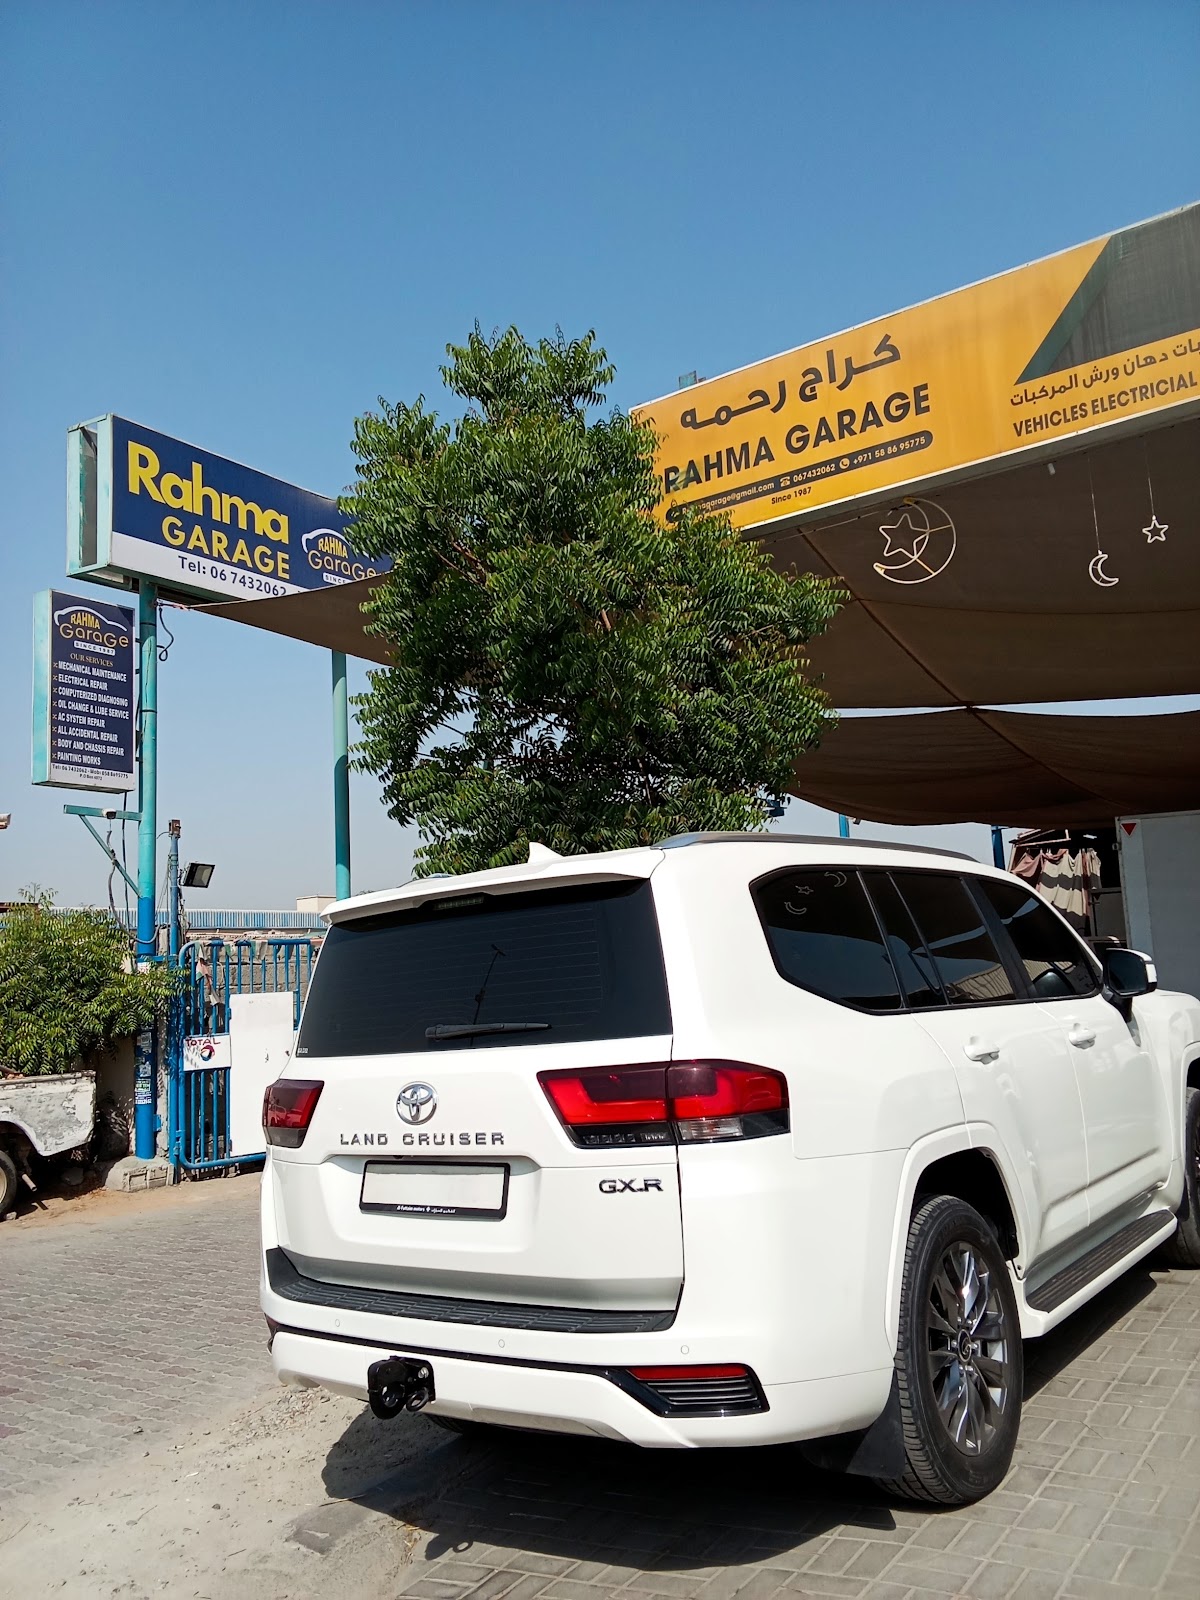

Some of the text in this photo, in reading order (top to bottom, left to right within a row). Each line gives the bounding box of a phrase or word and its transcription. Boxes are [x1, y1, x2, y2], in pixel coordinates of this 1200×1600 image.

[799, 334, 900, 402] كراج
[1011, 374, 1078, 406] المركبات
[1013, 371, 1198, 437] VEHICLES ELECTRICIAL
[664, 383, 930, 494] RAHMA GARAGE
[793, 463, 836, 483] 067432062
[853, 452, 872, 465] +971
[875, 448, 885, 458] 58
[887, 446, 897, 455] 86
[900, 437, 926, 450] 95775
[128, 440, 289, 545] Rahma
[794, 487, 812, 498] 1987
[161, 516, 290, 580] GARAGE
[318, 536, 349, 559] RAHMA
[178, 555, 287, 597] Tel: 06 7432062
[71, 612, 100, 630] RAHMA
[75, 642, 115, 655] SINCE 1987
[70, 653, 113, 667] OUR SERVICES
[58, 661, 126, 682] MECHANICAL MAINTENANCE
[58, 674, 108, 691] ELECTRICAL REPAIR
[58, 686, 128, 707] COMPUTERIZED DIAGNOSING
[57, 712, 105, 728] AC SYSTEM REPAIR
[58, 699, 129, 720] OIL CHANGE & LUBE SERVICE
[57, 725, 118, 743] ALL ACCIDENTAL REPAIR
[57, 738, 124, 757] BODY AND CHASSIS REPAIR
[58, 752, 100, 765] PAINTING WORKS
[186, 1038, 221, 1046] TOTAL
[340, 1132, 505, 1146] LAND CRUISER
